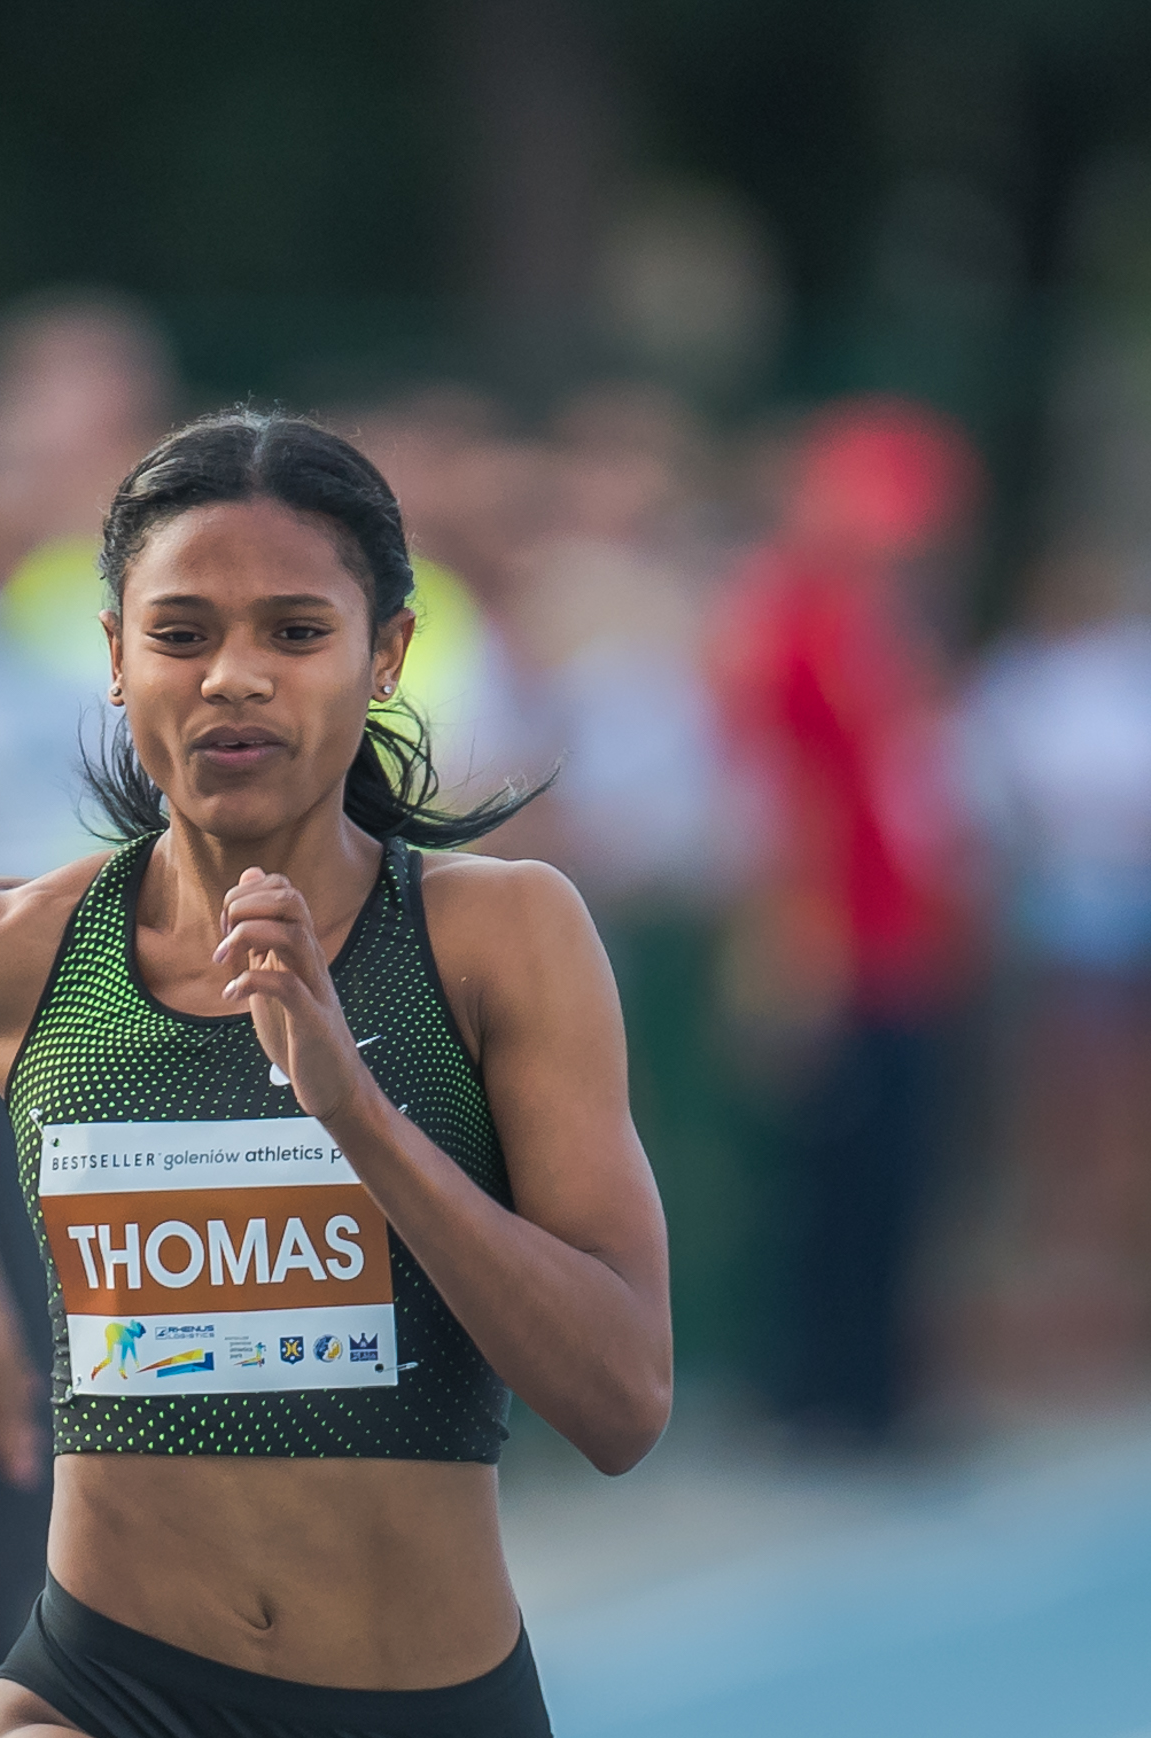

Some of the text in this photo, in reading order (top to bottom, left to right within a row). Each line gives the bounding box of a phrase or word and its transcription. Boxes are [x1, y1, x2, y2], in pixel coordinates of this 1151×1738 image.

[52, 1153, 156, 1171] BESTSELLER
[163, 1149, 241, 1171] goleniów
[245, 1145, 324, 1163] athletics
[67, 1214, 364, 1289] THOMAS
